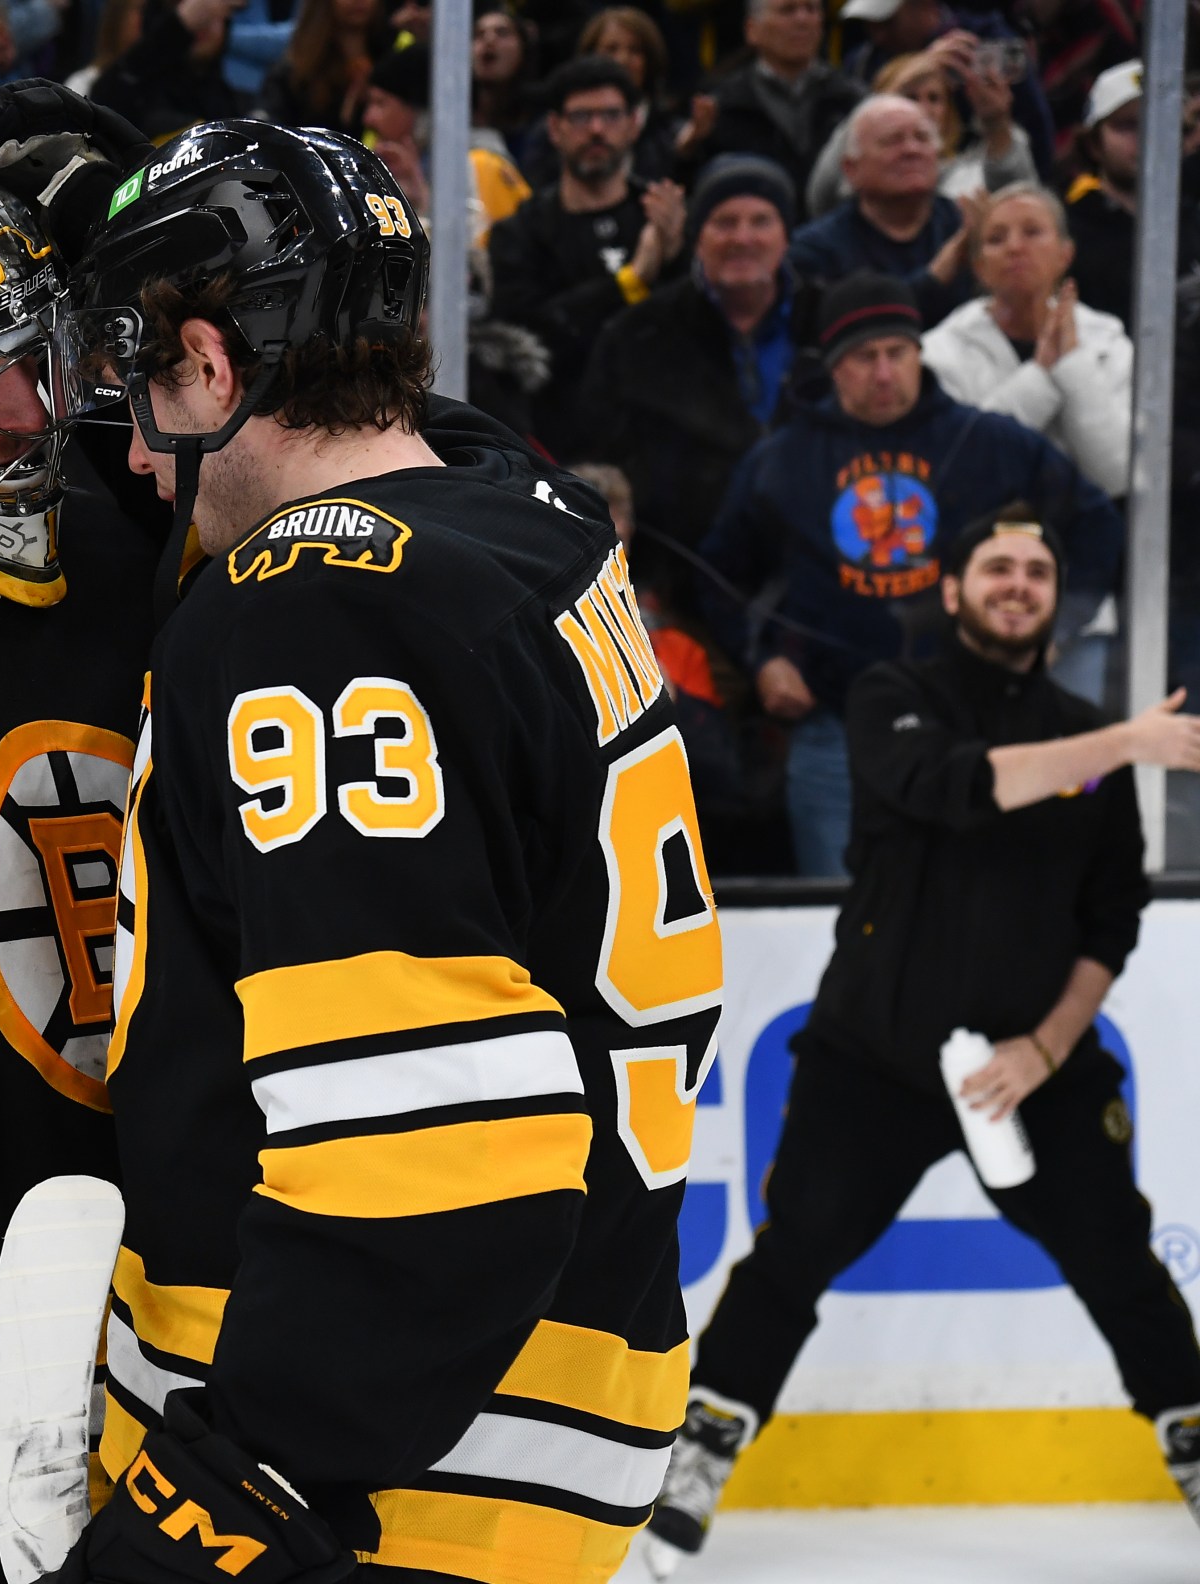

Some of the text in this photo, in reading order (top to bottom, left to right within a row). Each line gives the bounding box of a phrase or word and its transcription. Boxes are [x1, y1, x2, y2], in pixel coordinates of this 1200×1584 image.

[148, 145, 204, 183] Bank
[365, 192, 412, 239] 93
[95, 387, 121, 397] CCM
[268, 506, 376, 540] BRUINS
[227, 676, 445, 854] 93
[241, 1480, 290, 1521] MINTEN
